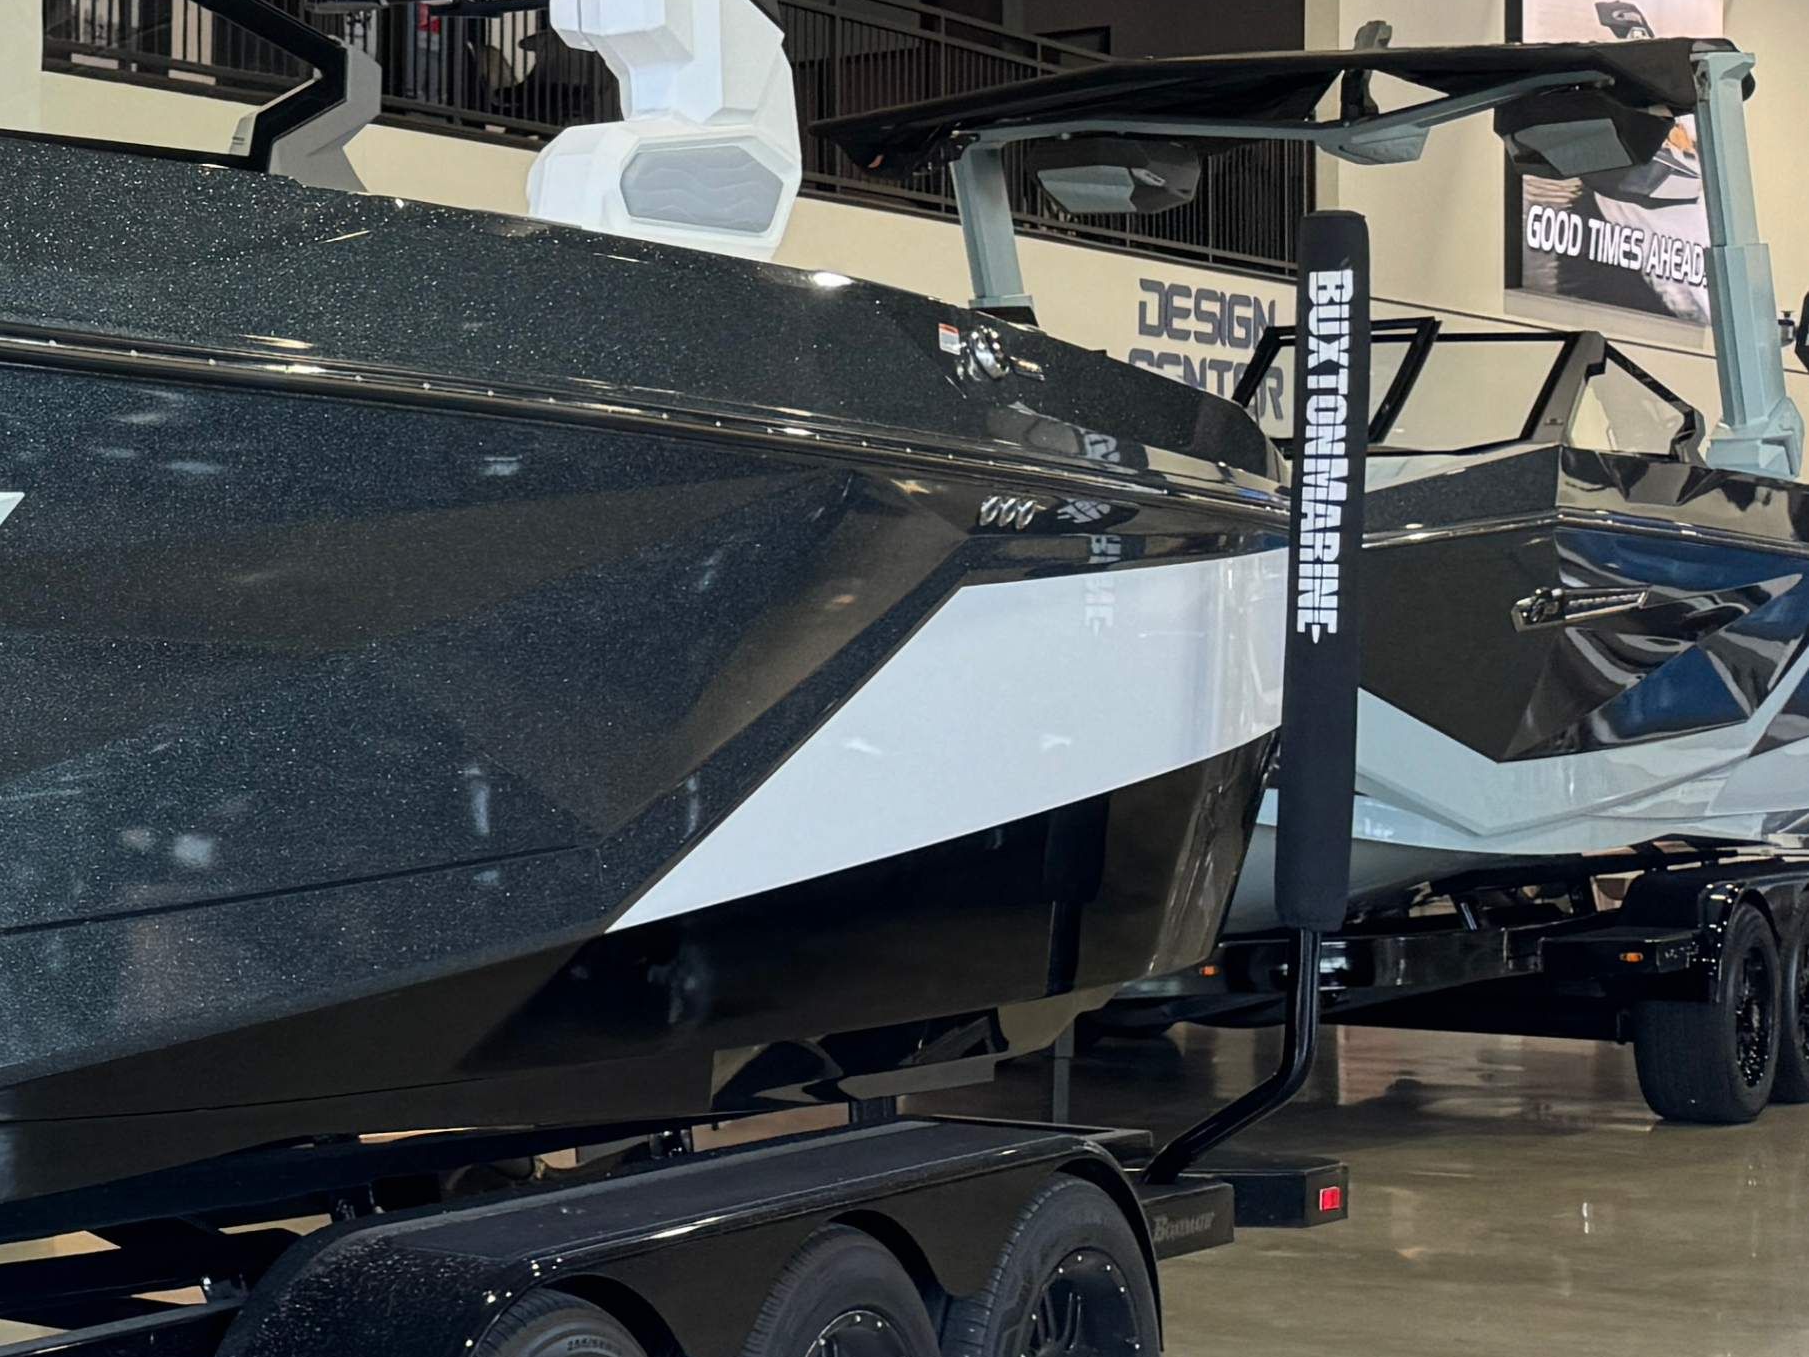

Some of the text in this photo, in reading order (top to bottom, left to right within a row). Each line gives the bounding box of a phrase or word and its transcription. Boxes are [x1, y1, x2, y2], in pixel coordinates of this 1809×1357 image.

[1526, 204, 1583, 257] GOOD
[1588, 218, 1645, 271] TIMES
[1138, 278, 1276, 351] DESIGN
